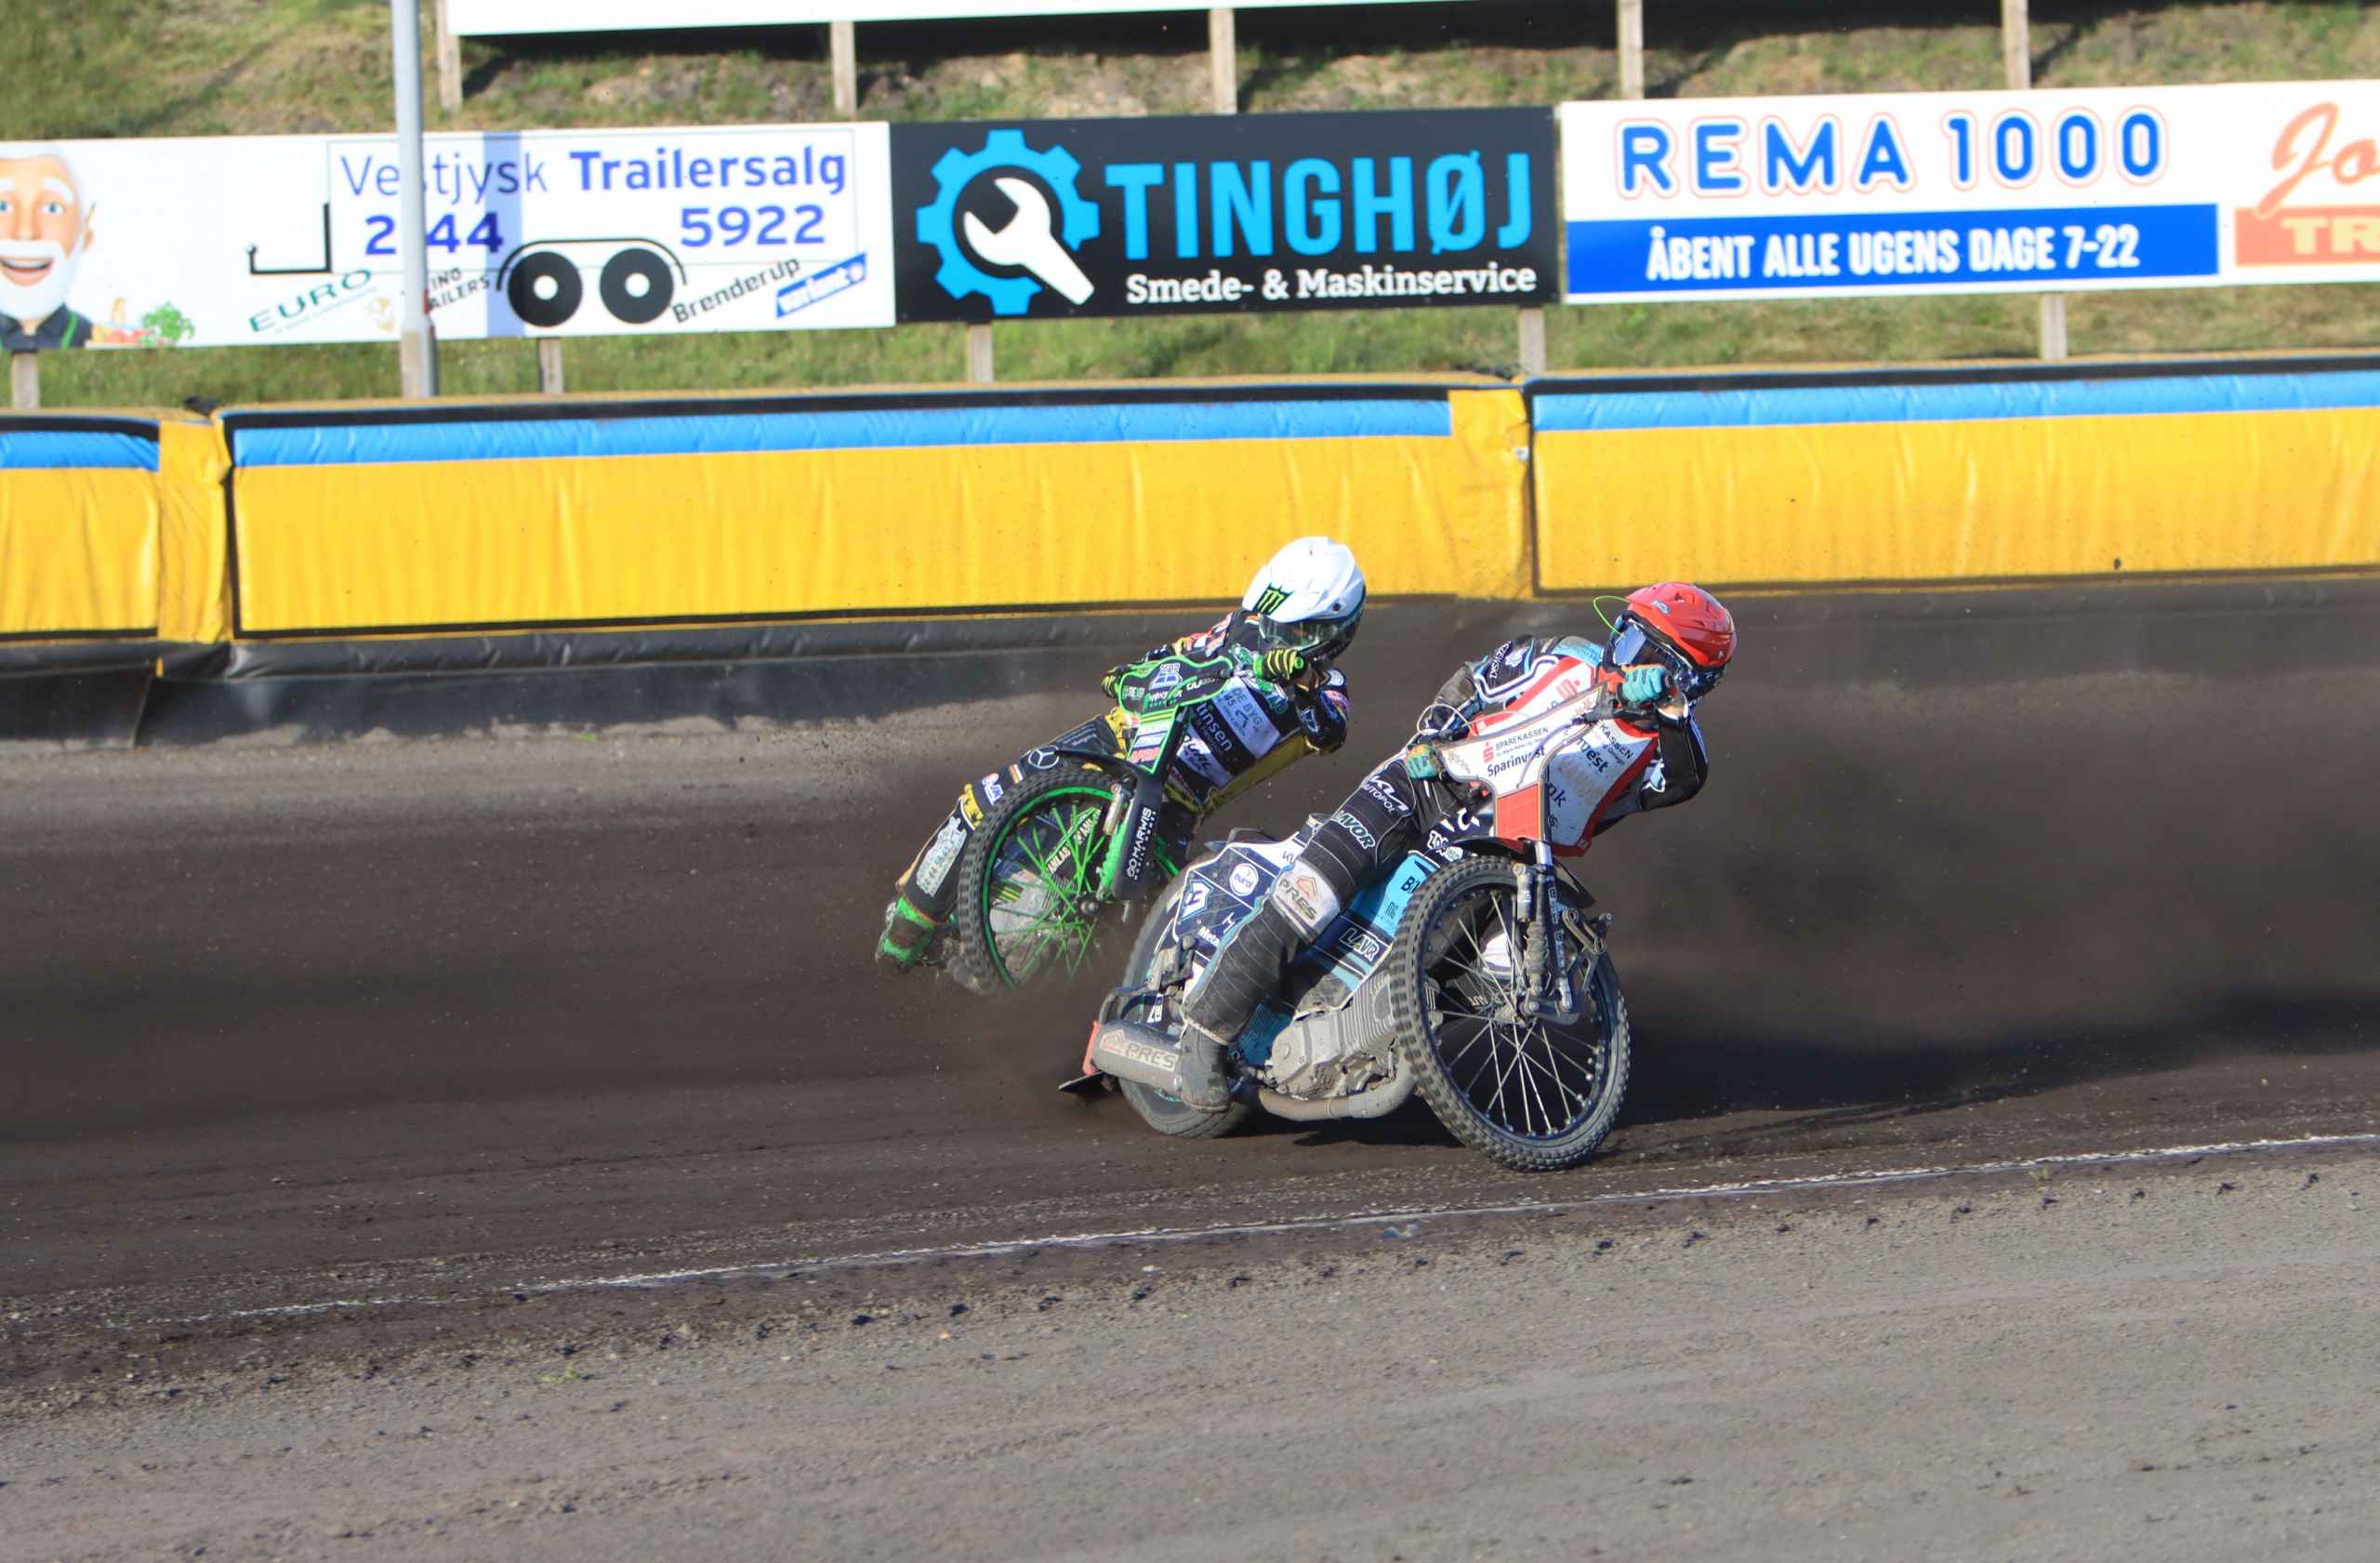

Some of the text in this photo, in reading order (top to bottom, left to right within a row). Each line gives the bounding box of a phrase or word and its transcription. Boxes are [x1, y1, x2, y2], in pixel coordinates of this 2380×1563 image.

[340, 145, 847, 205] Vetjysk Trailersalg
[1620, 112, 2161, 192] REMA 1000
[364, 204, 826, 257] 244 5922
[1104, 149, 1533, 259] TINGHØJ
[1646, 223, 2141, 282] ÅBENT ALLE UGENS DAGE 7-22
[248, 269, 373, 333] EURO
[670, 258, 800, 324] Brenderup
[1125, 261, 1538, 305] Smede- & Maskinservice
[1597, 719, 1635, 761] EKASSEN
[1361, 782, 1396, 815] UTOPOL
[1131, 806, 1152, 860] MARWIS
